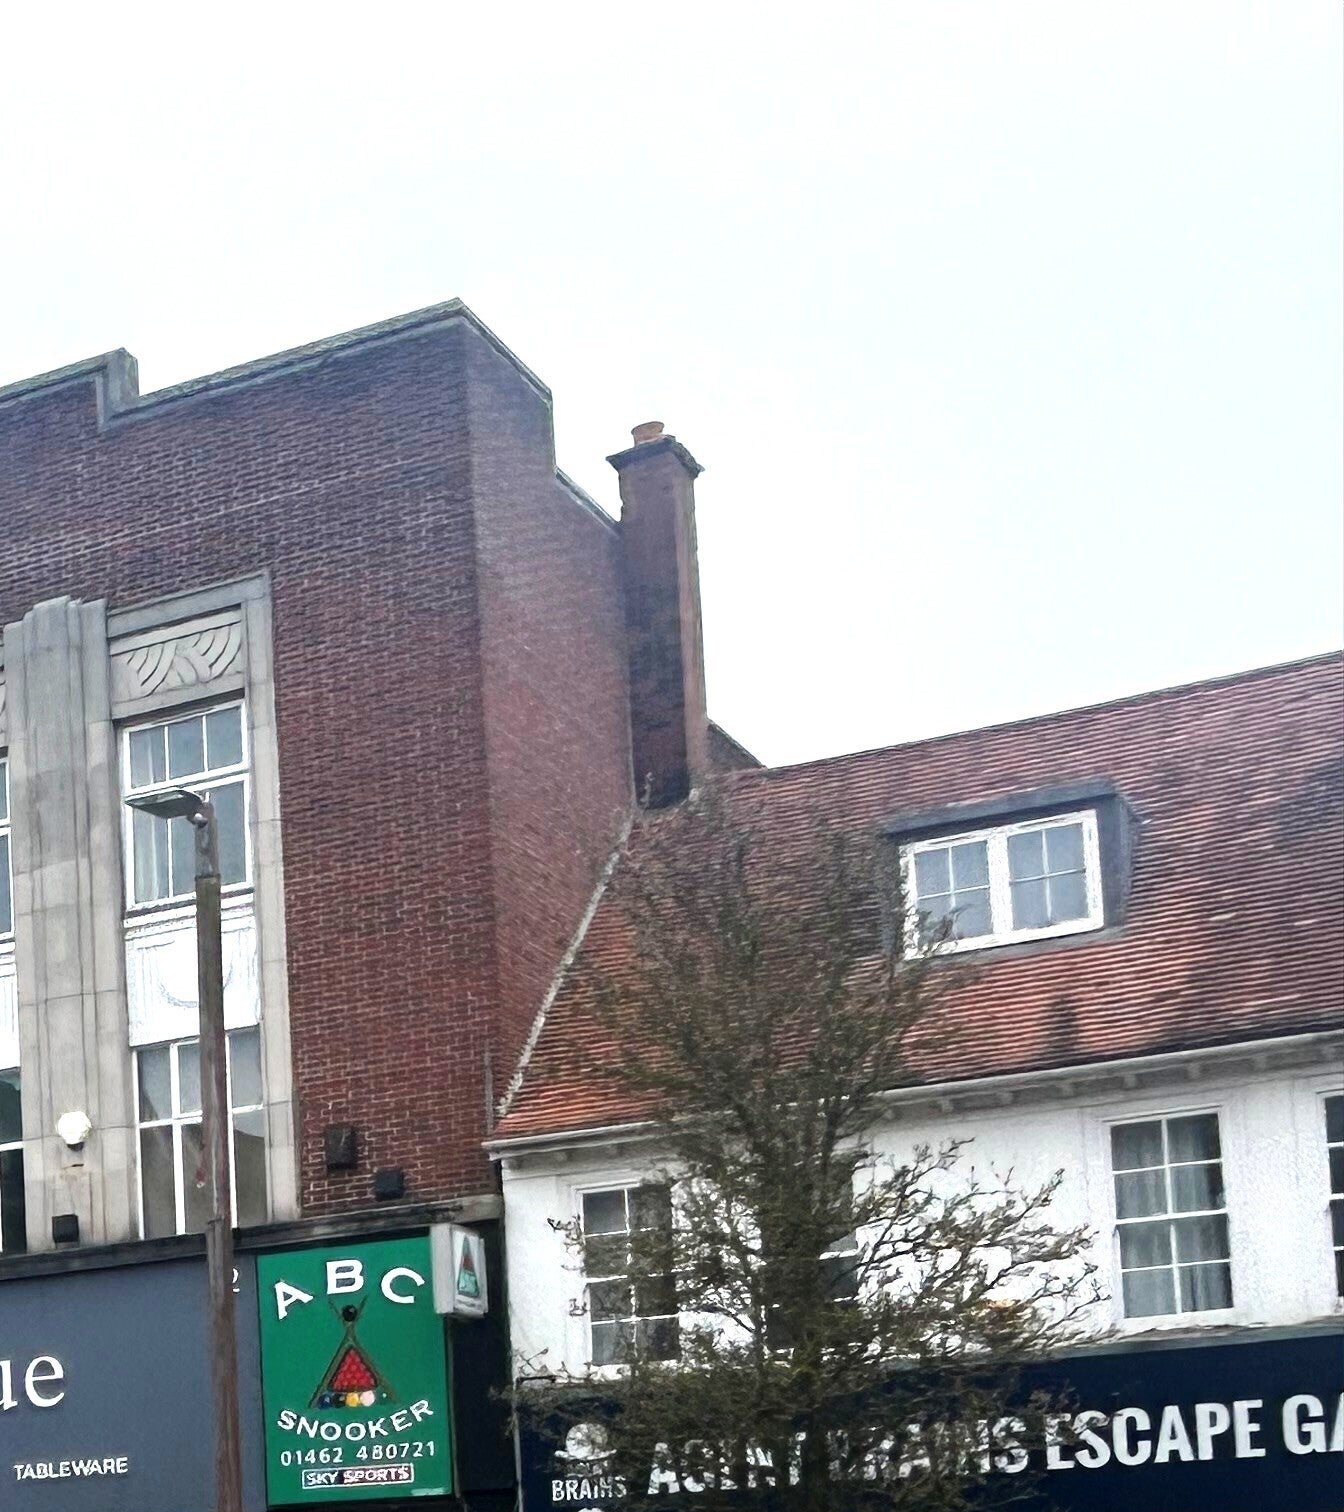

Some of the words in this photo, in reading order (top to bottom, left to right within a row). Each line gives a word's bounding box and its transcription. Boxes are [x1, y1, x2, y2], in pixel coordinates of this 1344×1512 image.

[277, 1399, 434, 1441] SNOOKER
[1045, 1399, 1266, 1470] ESCAPE
[280, 1447, 344, 1467] 01462
[356, 1440, 435, 1461] 480721
[13, 1456, 129, 1481] TABLEWARE
[306, 1472, 339, 1486] SKY
[342, 1466, 410, 1484] SPORTS
